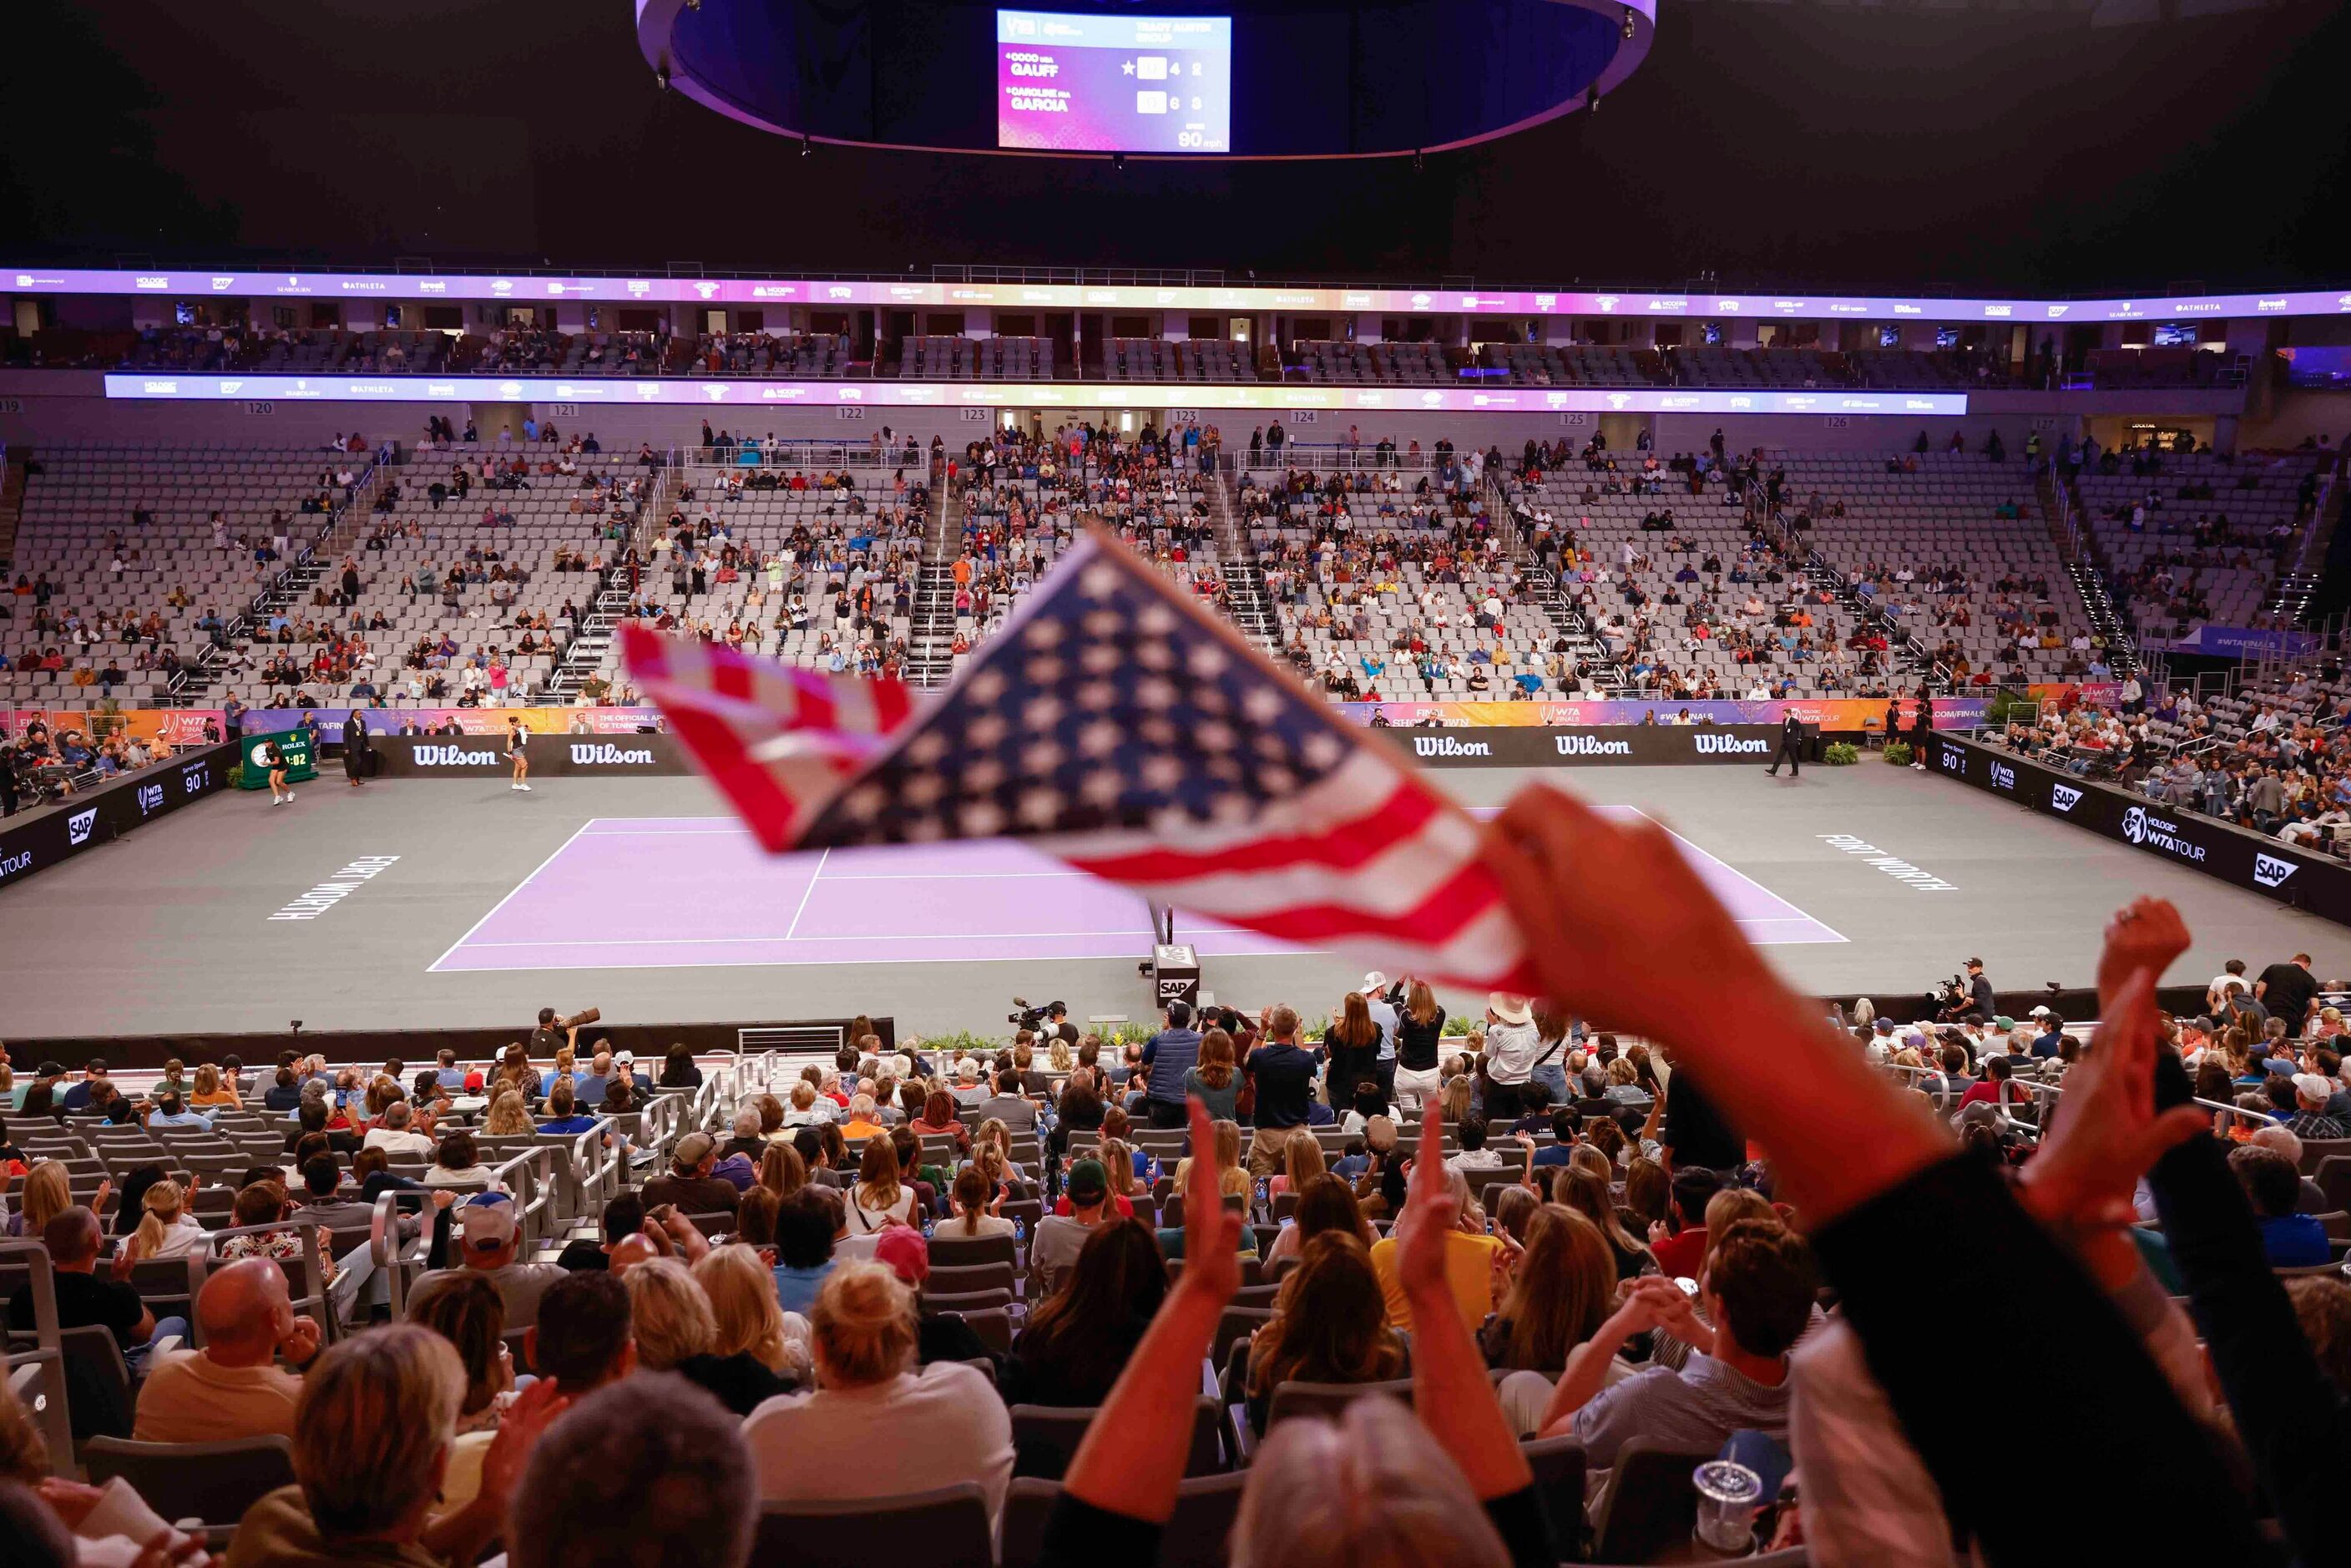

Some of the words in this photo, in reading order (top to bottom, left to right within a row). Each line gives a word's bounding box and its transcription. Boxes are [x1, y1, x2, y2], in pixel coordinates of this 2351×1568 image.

[1011, 63, 1059, 77] GAUFF
[1170, 62, 1181, 75] 4
[1011, 97, 1068, 112] GARCIA
[1170, 96, 1180, 109] 6
[1179, 131, 1202, 147] 90
[1203, 139, 1222, 149] mph
[2183, 303, 2220, 311] ATHLETA
[250, 403, 272, 414] 120
[555, 405, 574, 416] 121
[841, 408, 862, 418] 122
[964, 410, 985, 420] 123
[1176, 411, 1196, 421] 123
[1294, 412, 1315, 422] 124
[1564, 414, 1584, 424] 125
[1828, 417, 1847, 427] 126
[2036, 420, 2054, 429] 127
[1556, 707, 1580, 716] WTA
[282, 741, 306, 751] ROLEX
[1414, 736, 1489, 756] Wilson
[1555, 735, 1630, 755] Wilson
[1694, 734, 1767, 753] Wilson
[413, 745, 496, 766] Wilson
[570, 743, 653, 764] Wilson
[1943, 752, 1957, 769] 90
[2000, 766, 2015, 779] WTA
[186, 773, 200, 792] 90
[1999, 775, 2014, 786] FINALS
[147, 784, 162, 796] WTA
[149, 792, 163, 804] FINALS
[2055, 788, 2075, 807] SAP
[70, 817, 91, 839] SAP
[2148, 817, 2177, 833] HOLOGIC
[2147, 829, 2206, 862] WTATOUR
[331, 856, 401, 879] FORT
[1815, 834, 1888, 856] FORT
[1861, 857, 1959, 891] WORTH
[2256, 859, 2286, 883] SAP
[266, 882, 364, 920] WORTH
[1160, 983, 1187, 994] SAP
